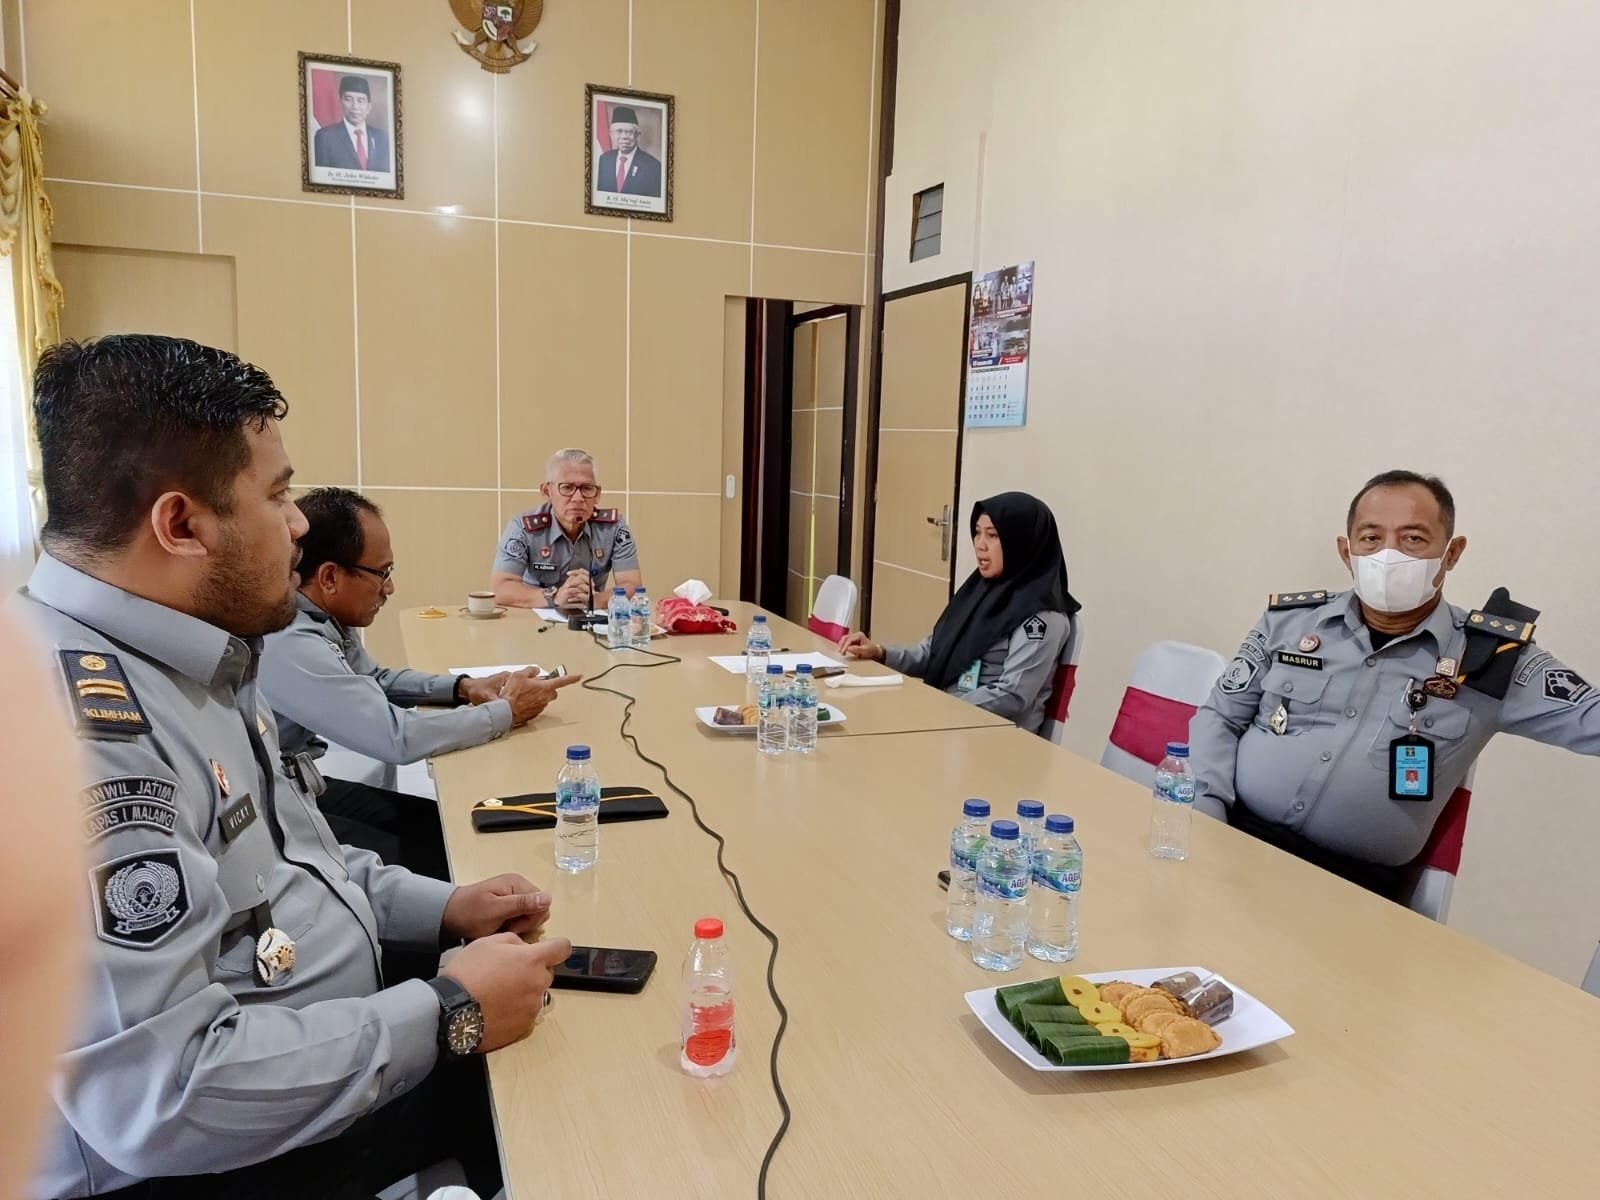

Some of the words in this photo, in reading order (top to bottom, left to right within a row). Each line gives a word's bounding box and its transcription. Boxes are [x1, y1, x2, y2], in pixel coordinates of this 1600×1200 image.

[1281, 653, 1319, 668] MASRUR
[83, 781, 131, 805] ANWIL
[136, 780, 173, 801] JATIM
[122, 807, 127, 822] I
[132, 805, 173, 826] MALANG
[229, 805, 250, 829] VICKY
